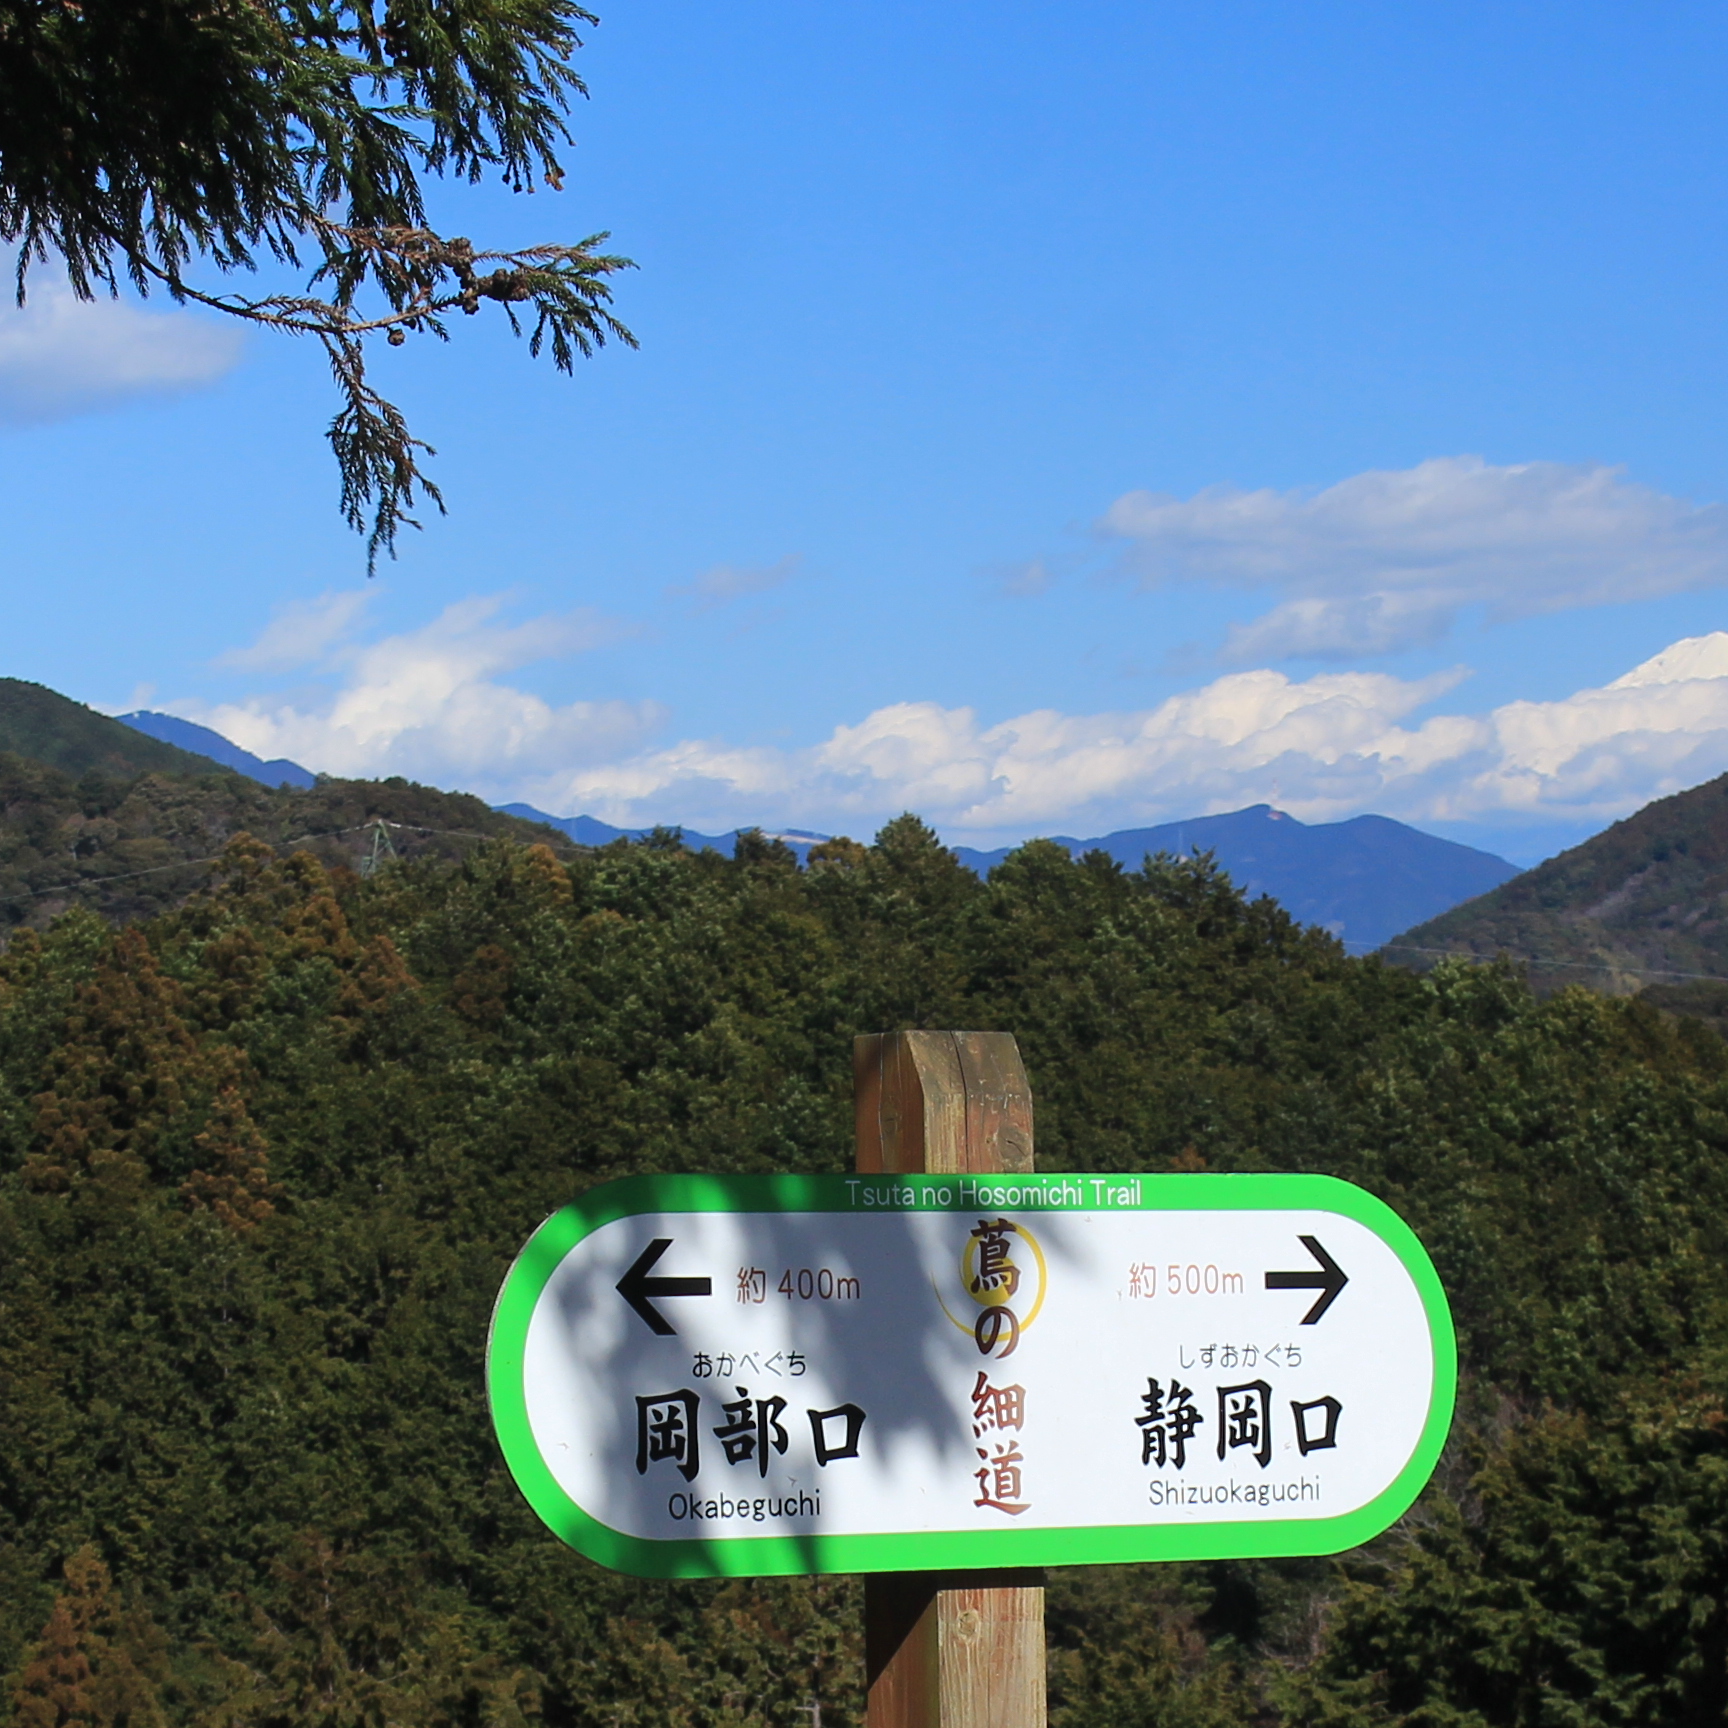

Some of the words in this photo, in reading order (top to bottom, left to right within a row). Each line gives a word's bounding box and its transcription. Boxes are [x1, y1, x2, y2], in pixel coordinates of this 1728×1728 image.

[845, 1180, 915, 1206] Tsuta
[922, 1186, 952, 1206] no
[959, 1179, 1083, 1206] Hosomichi
[1091, 1180, 1142, 1206] Trail
[692, 1351, 807, 1378] おかべぐち
[970, 1218, 1032, 1516] 蔦の細道
[1178, 1343, 1302, 1368] しずおかぐち
[635, 1386, 866, 1482] 岡部口
[1134, 1377, 1343, 1470] 静岡口
[668, 1489, 821, 1522] Okabeguchi
[1149, 1476, 1320, 1508] Shizuokaguchi
